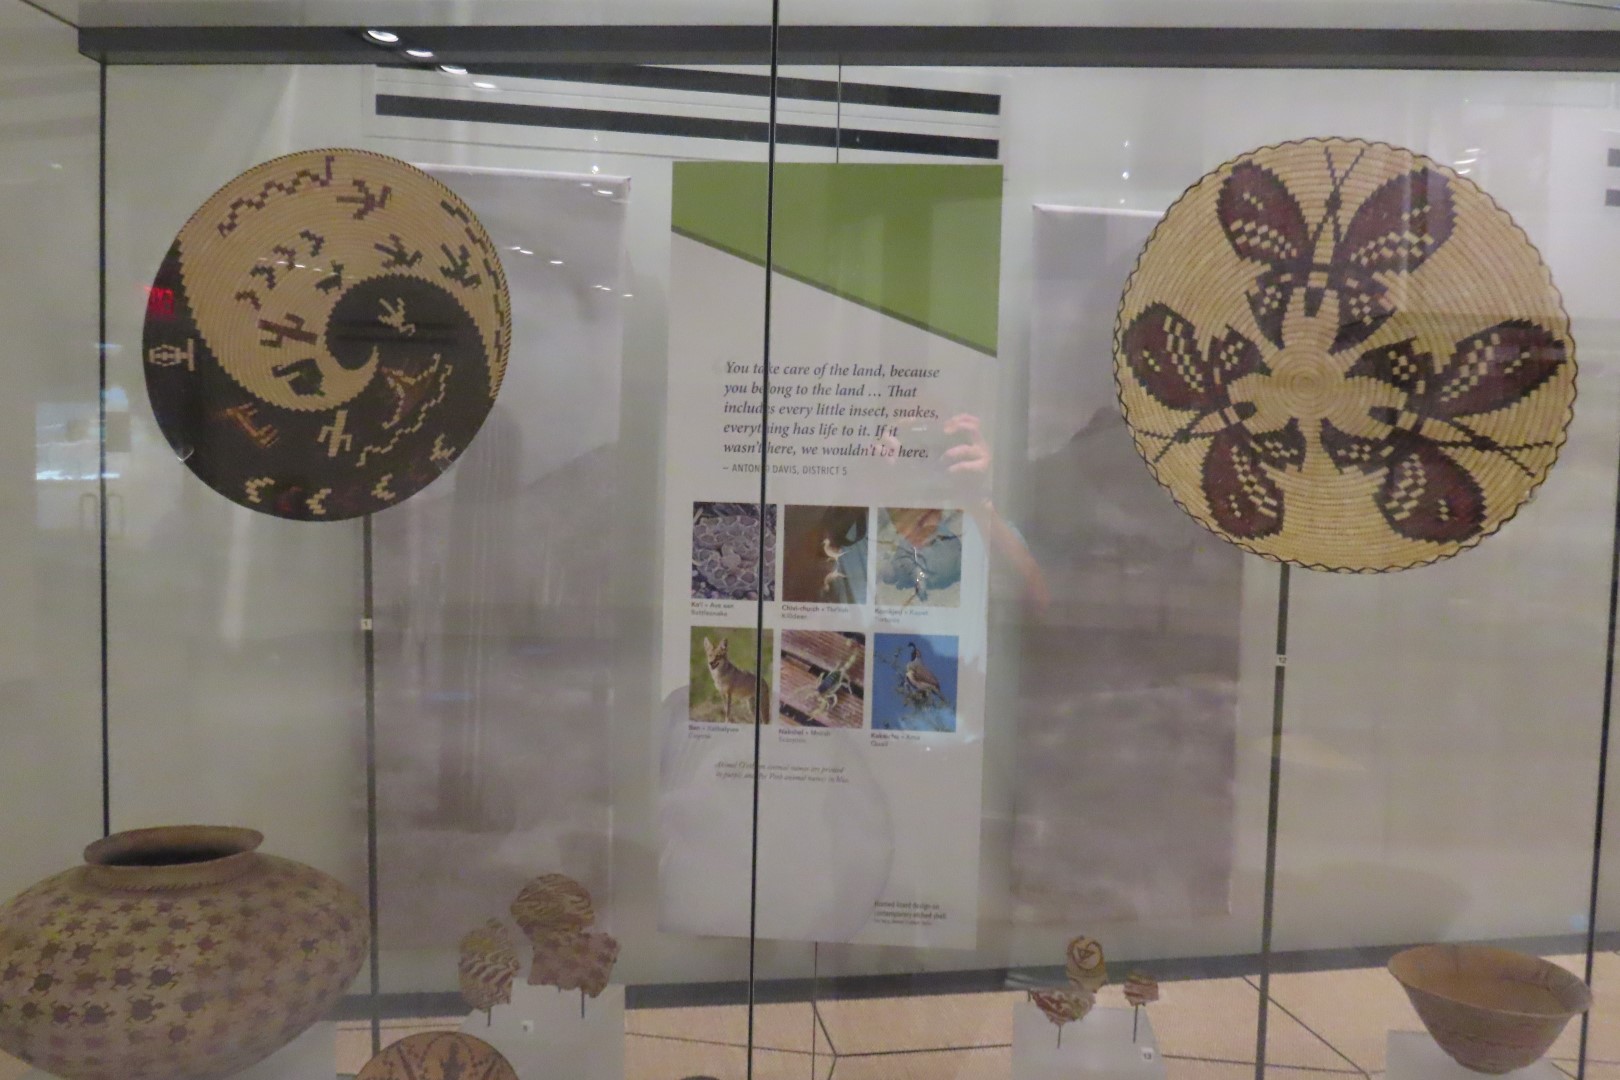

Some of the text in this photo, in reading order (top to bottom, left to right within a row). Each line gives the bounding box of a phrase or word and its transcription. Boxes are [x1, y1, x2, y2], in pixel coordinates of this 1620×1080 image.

[726, 361, 749, 374] You
[783, 365, 810, 375] care
[813, 362, 828, 379] of
[830, 363, 849, 377] the
[852, 363, 885, 378] land,
[889, 364, 940, 378] because
[724, 384, 747, 397] you
[796, 384, 808, 395] to
[812, 382, 832, 396] the
[835, 383, 865, 396] land
[887, 384, 918, 398] That
[778, 404, 813, 418] every
[816, 403, 846, 416] little
[849, 404, 889, 418] insect,
[892, 405, 939, 419] snakes,
[792, 422, 816, 435] has
[818, 423, 838, 439] life
[841, 425, 854, 436] to
[858, 424, 871, 437] it.
[874, 424, 887, 440] If
[888, 425, 899, 437] it
[766, 442, 796, 456] here,
[801, 445, 818, 455] we
[822, 443, 877, 456] wouldn't
[880, 444, 895, 457] be
[897, 445, 929, 458] here.
[772, 464, 800, 475] DAVIS,
[802, 465, 839, 476] DISTRICT
[842, 466, 848, 476] 5
